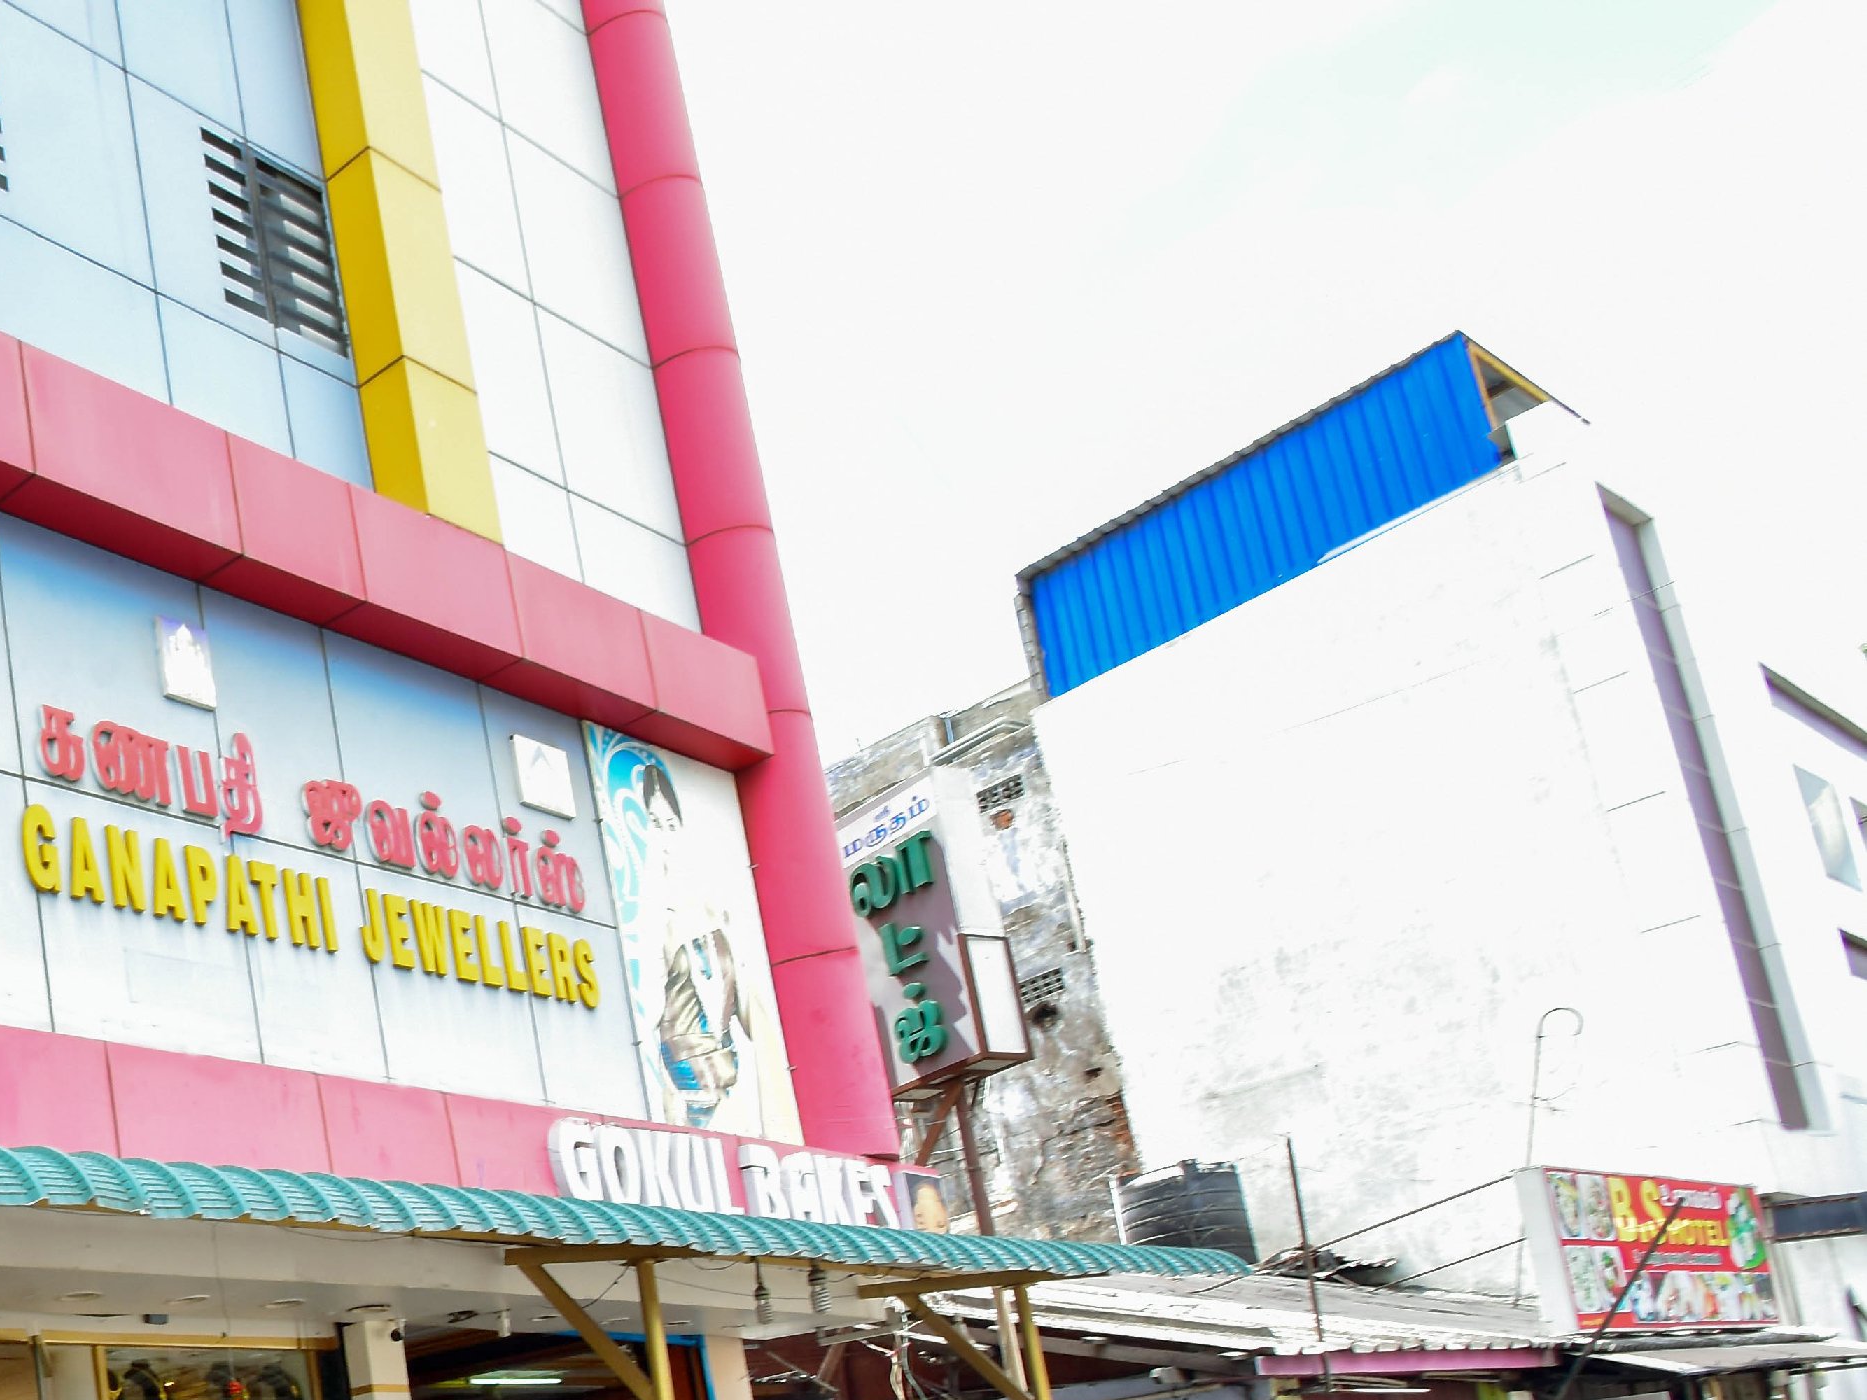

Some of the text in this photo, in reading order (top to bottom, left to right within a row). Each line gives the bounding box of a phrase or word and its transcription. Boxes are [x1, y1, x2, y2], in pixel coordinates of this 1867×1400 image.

[40, 702, 265, 842] கணபதி
[844, 796, 931, 858] மருதம்
[21, 804, 340, 954] GANAPATHI
[361, 887, 601, 1010] JEWELLERS
[548, 1116, 745, 1215] GOKUL
